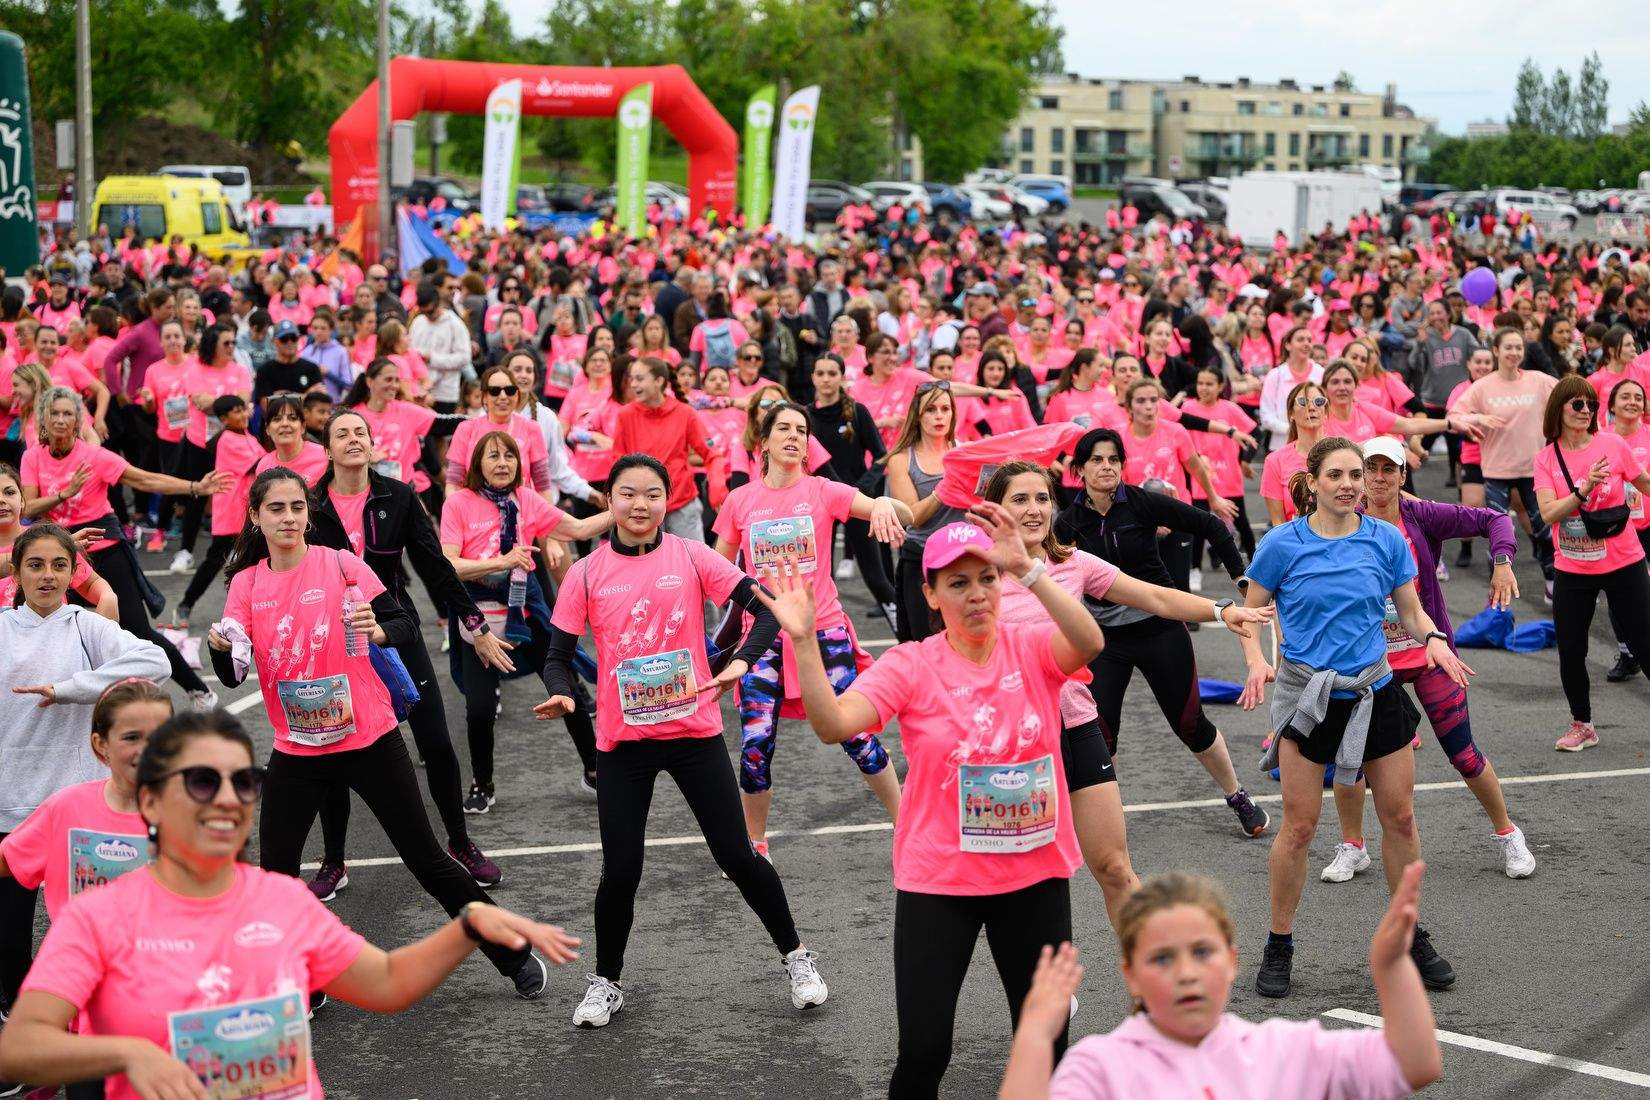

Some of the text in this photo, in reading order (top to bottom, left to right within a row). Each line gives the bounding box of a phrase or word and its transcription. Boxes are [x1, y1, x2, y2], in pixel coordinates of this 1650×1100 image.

[552, 80, 613, 97] Santander
[772, 543, 795, 554] 016
[599, 584, 632, 596] OYSHO
[642, 664, 671, 673] ASTURIANA
[297, 689, 325, 697] ASTURIANA
[646, 683, 673, 698] 016
[303, 708, 330, 720] 016
[993, 775, 1028, 786] ASTURIANA
[994, 802, 1030, 818] 016
[971, 839, 1004, 848] OYSHO
[97, 847, 137, 858] ASTURIANA
[225, 1055, 277, 1084] 016
